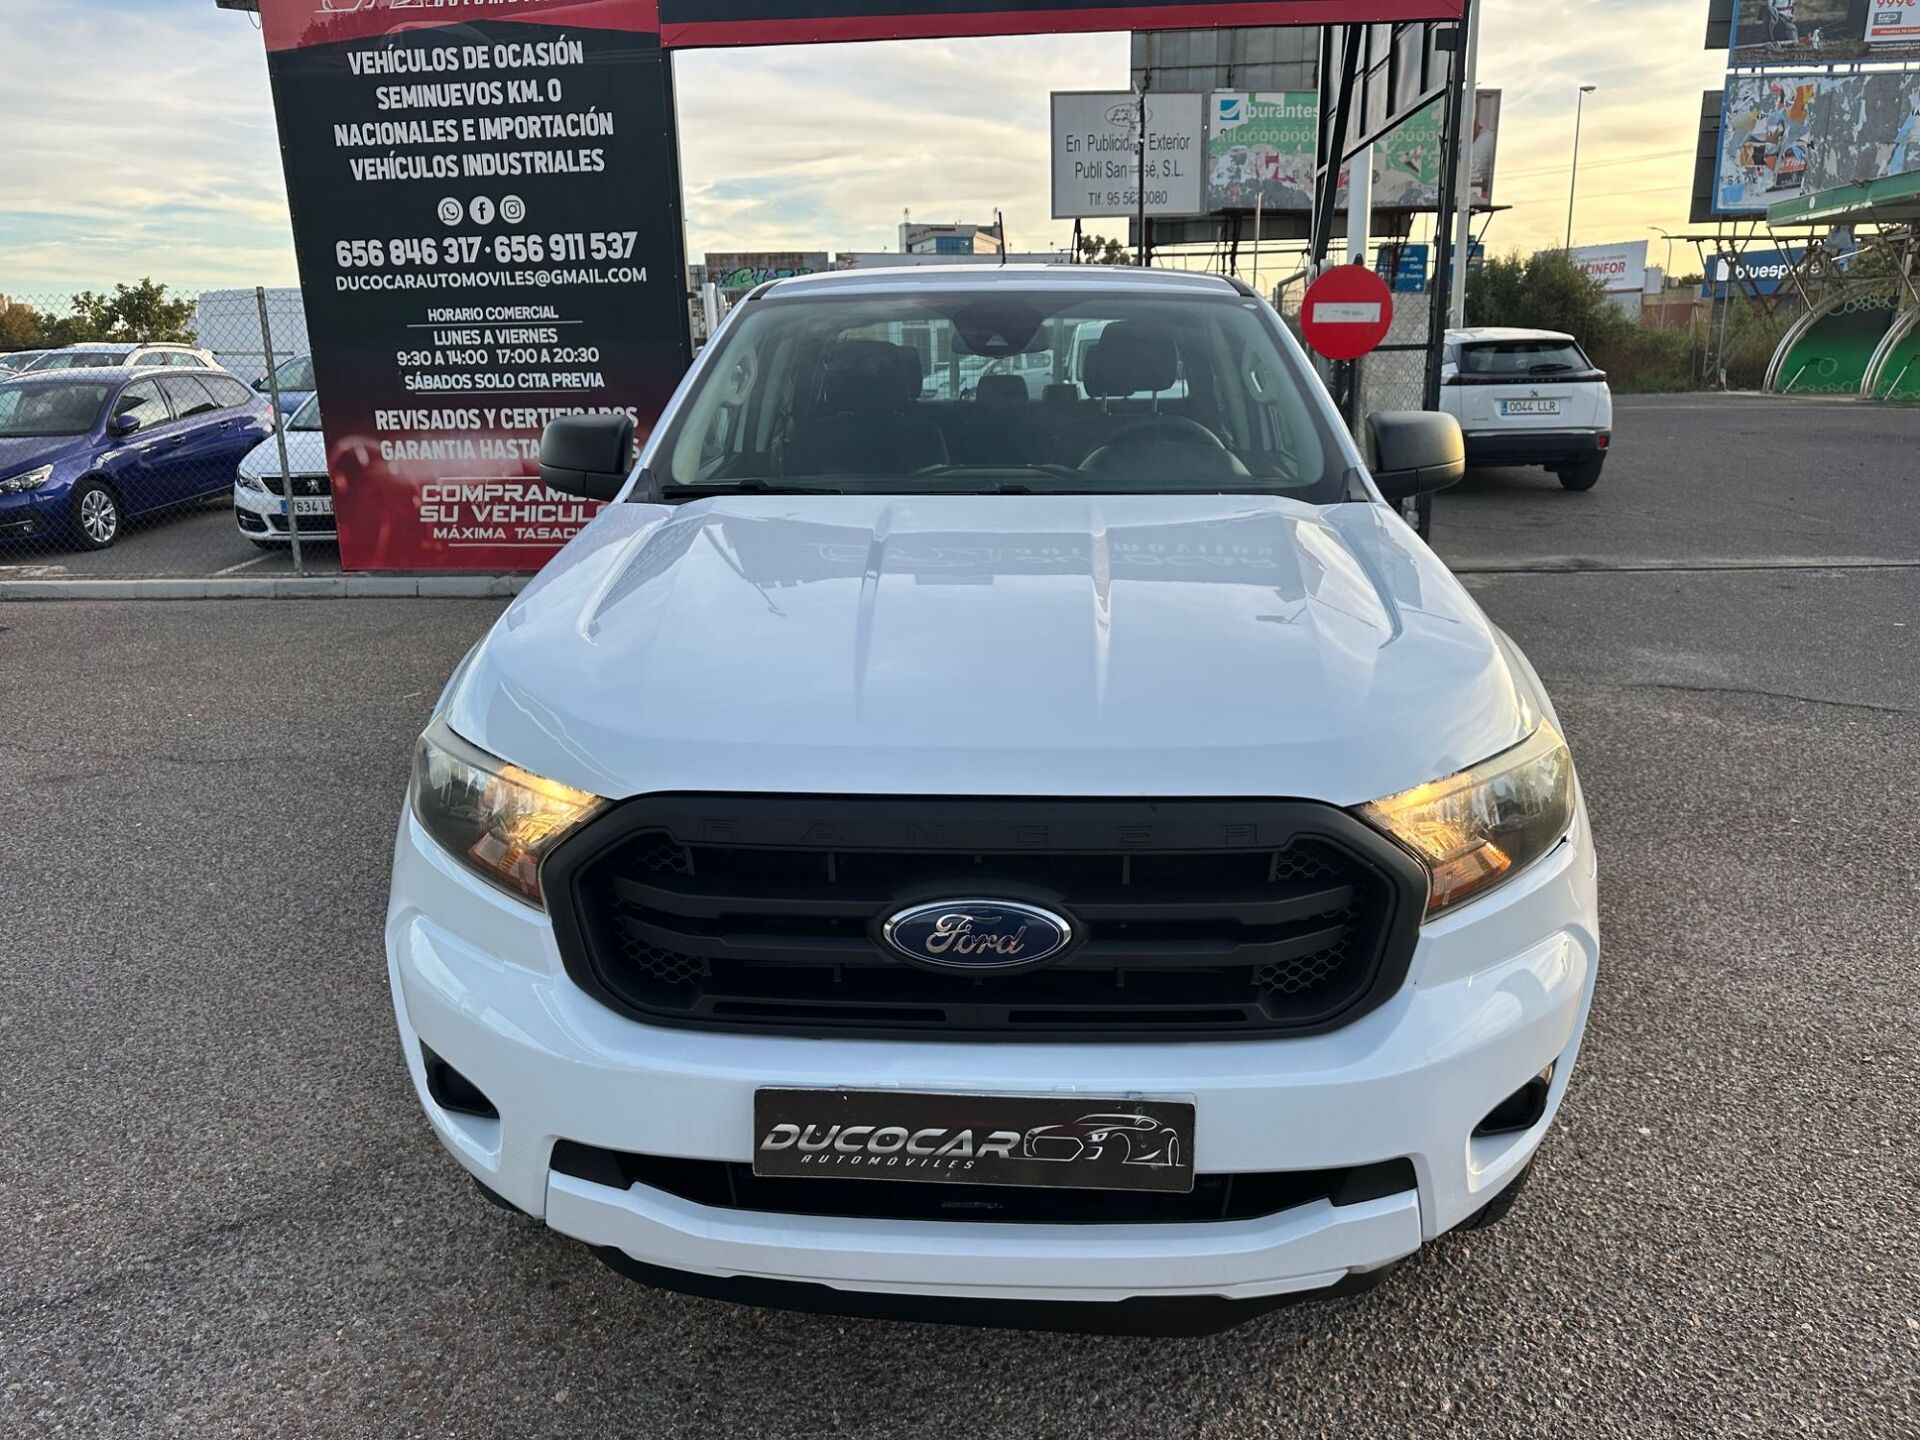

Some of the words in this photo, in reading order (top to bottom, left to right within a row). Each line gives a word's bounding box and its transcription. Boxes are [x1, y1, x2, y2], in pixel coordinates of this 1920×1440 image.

[347, 43, 458, 75] VEHÍCULOS
[462, 45, 491, 70] DE
[494, 34, 584, 68] OCASIÓN
[375, 81, 502, 110] SEMINUEVOS
[507, 79, 544, 105] KM.
[333, 118, 458, 147] NACIONALES
[462, 118, 476, 141] E
[479, 106, 614, 141] IMPORTACIÓN
[1066, 134, 1080, 152] En
[1087, 133, 1134, 151] Publicid
[1149, 133, 1191, 150] Exterior
[349, 150, 459, 181] VEHÍCULOS
[462, 148, 605, 177] INDUSTRIALES
[1075, 161, 1102, 179] Publi
[1105, 160, 1127, 178] San
[1162, 160, 1184, 177] S.L.
[1088, 192, 1103, 206] Tlf.
[1107, 192, 1120, 205] 95
[335, 239, 385, 268] 656
[389, 237, 438, 266] 846
[548, 232, 586, 261] 911
[590, 231, 638, 260] 537
[335, 267, 647, 291] DUCOCARAUTOMOVILES@GMAIL.COM
[427, 308, 483, 322] HORARIO
[485, 305, 559, 320] COMERCIAL
[433, 329, 481, 346] LUNES
[483, 330, 494, 345] A
[495, 328, 558, 345] VIERNES
[396, 350, 432, 366] 9:30
[434, 351, 445, 365] A
[446, 350, 488, 365] 14:00
[495, 348, 538, 364] 17:00
[540, 348, 551, 363] A
[553, 347, 600, 363] 20:30
[404, 372, 471, 390] SÁBADOS
[474, 373, 515, 389] SOLO
[517, 373, 550, 389] CITA
[551, 372, 605, 388] PREVIA
[1509, 401, 1533, 412] 0044
[1537, 400, 1556, 411] LLR
[374, 408, 481, 431] REVISADOS
[485, 408, 496, 429] Y
[380, 439, 478, 461] GARANTIA
[480, 438, 540, 460] HASTA
[422, 484, 604, 503] COMPRAM
[420, 505, 458, 522] SU
[433, 525, 506, 539] MÁXIMA
[515, 527, 580, 540] TASAC
[702, 818, 1259, 848] RANGER
[925, 913, 1026, 955] Ford
[759, 1123, 1022, 1158] DUCOCAR
